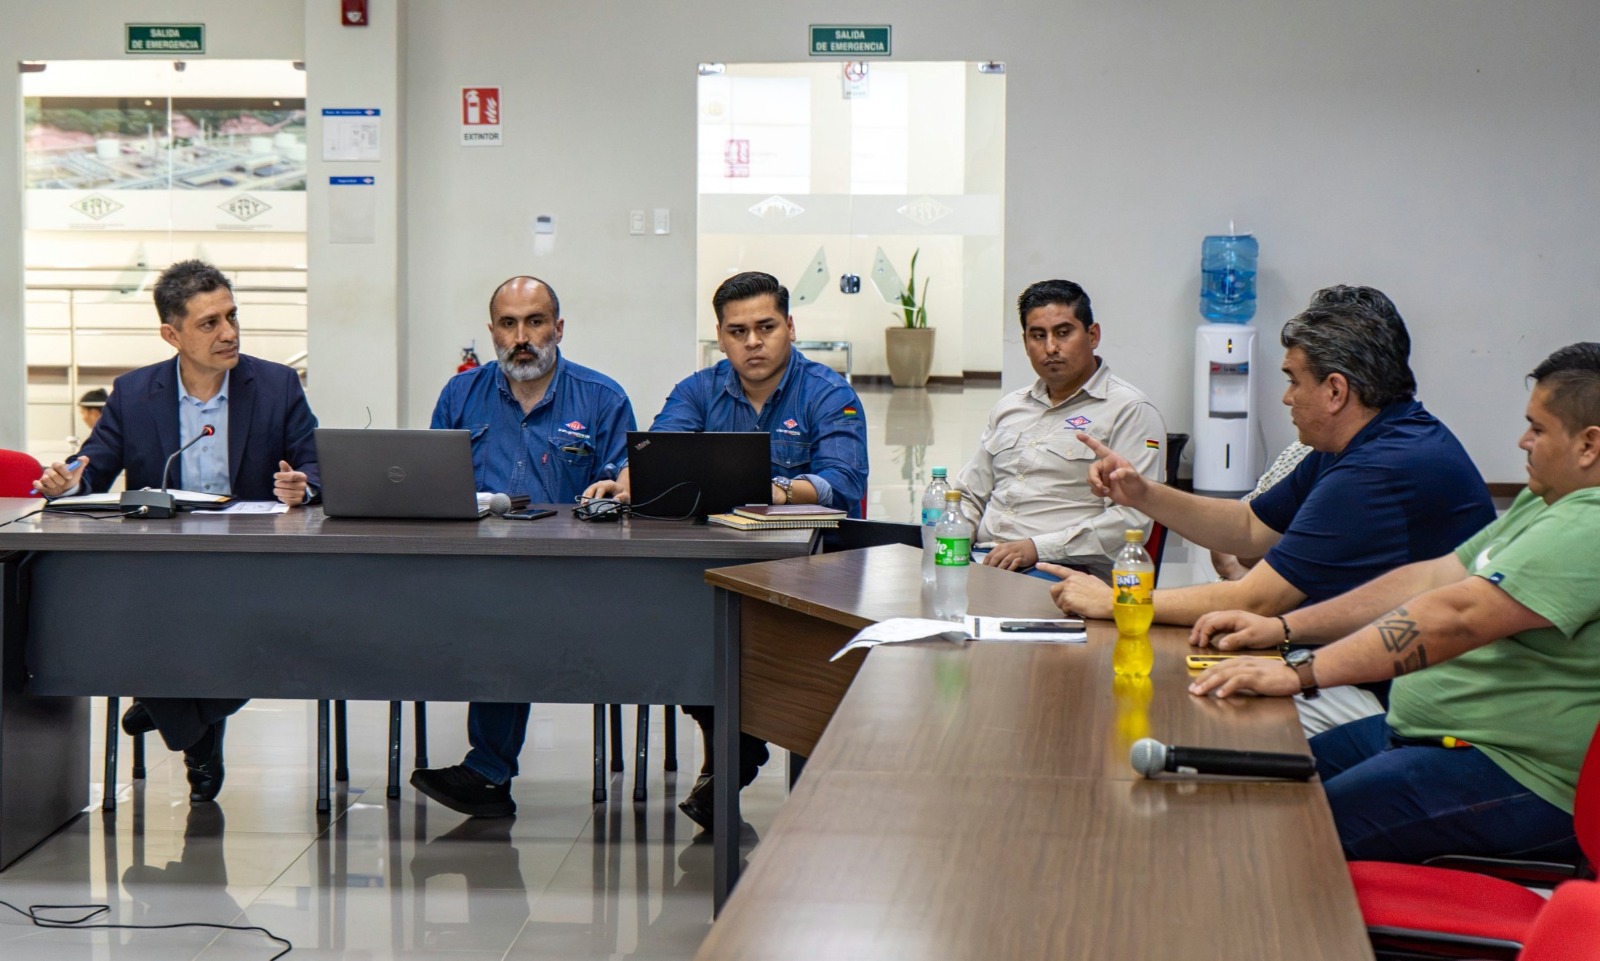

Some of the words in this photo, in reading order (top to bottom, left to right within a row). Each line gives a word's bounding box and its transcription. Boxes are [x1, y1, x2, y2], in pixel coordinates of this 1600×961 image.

[150, 28, 181, 38] SALIDA
[835, 30, 866, 40] SALIDA
[131, 39, 144, 49] DE
[145, 39, 200, 49] EMERGENCIA
[815, 41, 828, 51] DE
[830, 41, 885, 51] EMERGENCIA
[463, 132, 500, 141] EXTINTOR
[1116, 574, 1140, 586] FANTA
